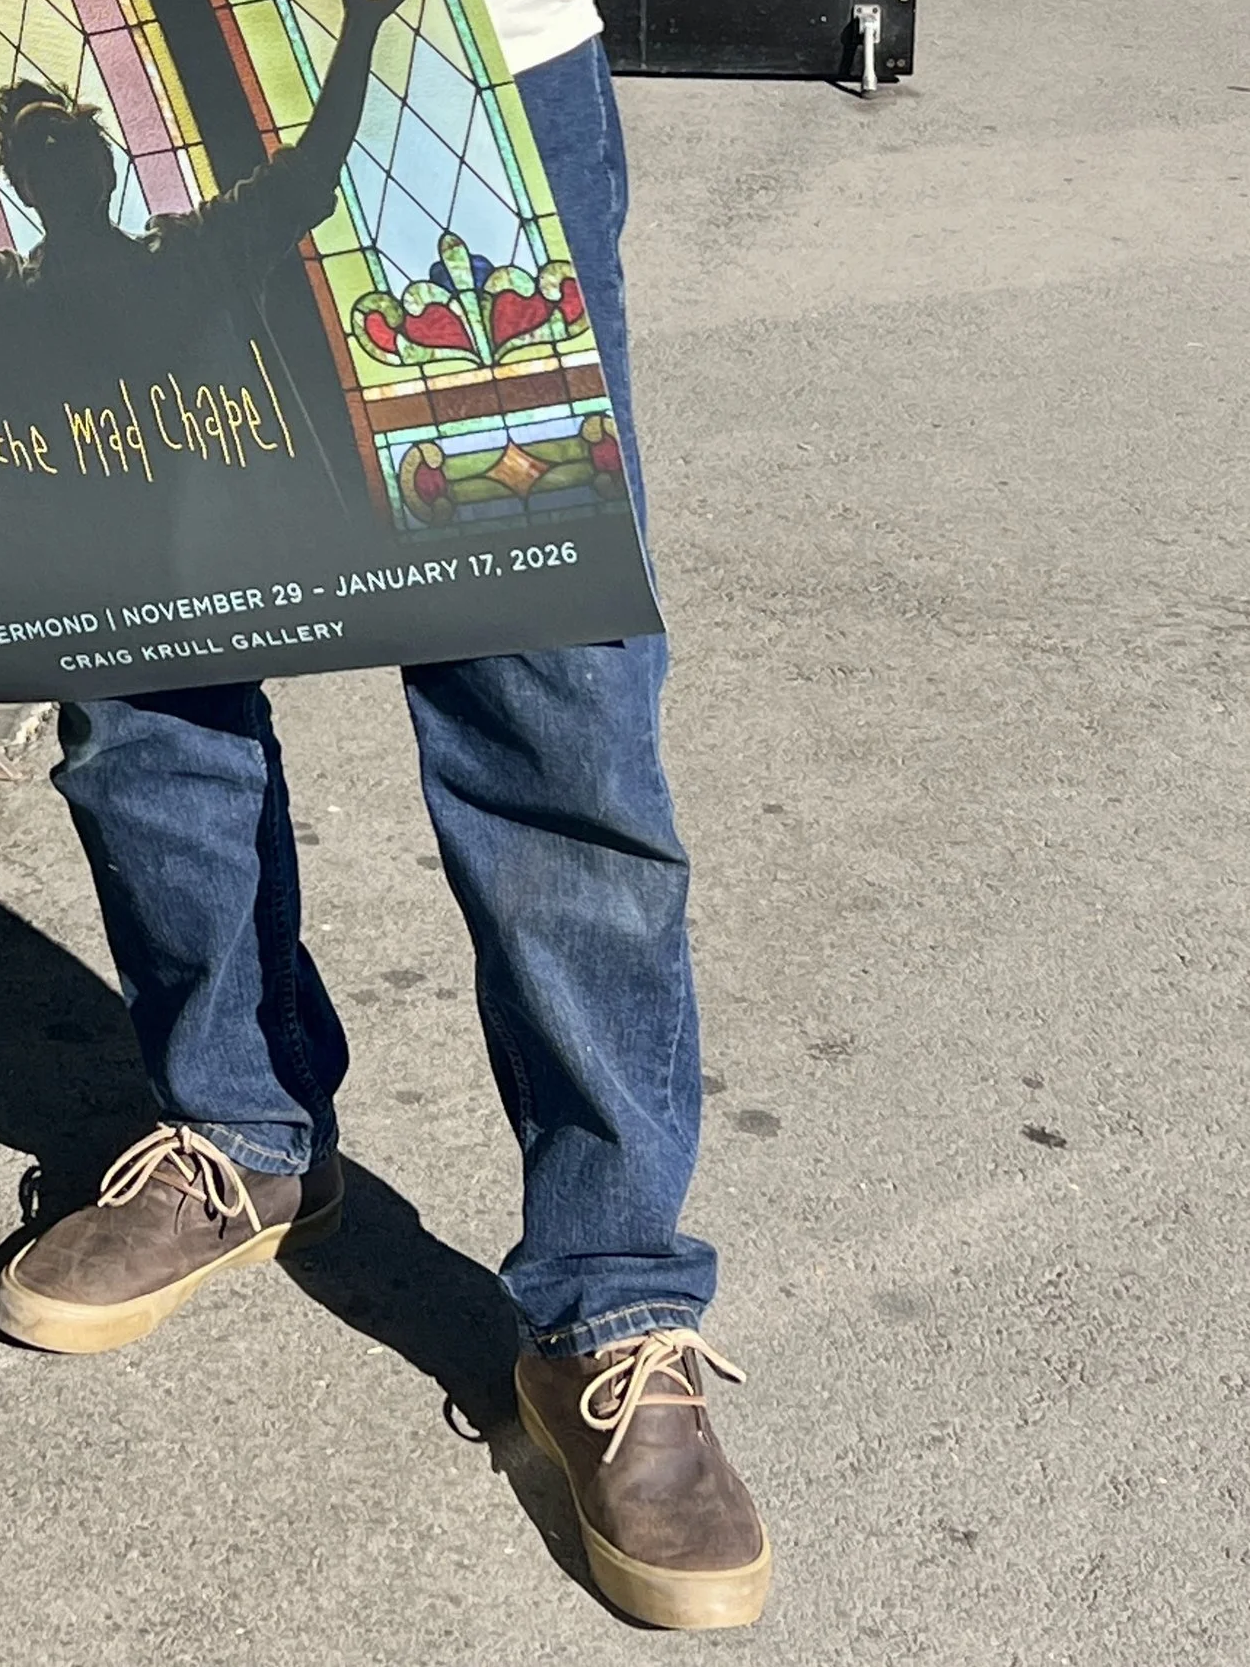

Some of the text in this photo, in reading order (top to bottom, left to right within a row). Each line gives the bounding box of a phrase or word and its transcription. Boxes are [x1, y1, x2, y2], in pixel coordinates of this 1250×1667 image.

[121, 588, 264, 627] NOVEMBER
[271, 582, 303, 607] 29
[335, 558, 459, 598] JANUARY
[468, 554, 502, 578] 17,
[510, 541, 578, 571] 2026
[59, 620, 345, 672] CRAIG KRULL GALLERY
